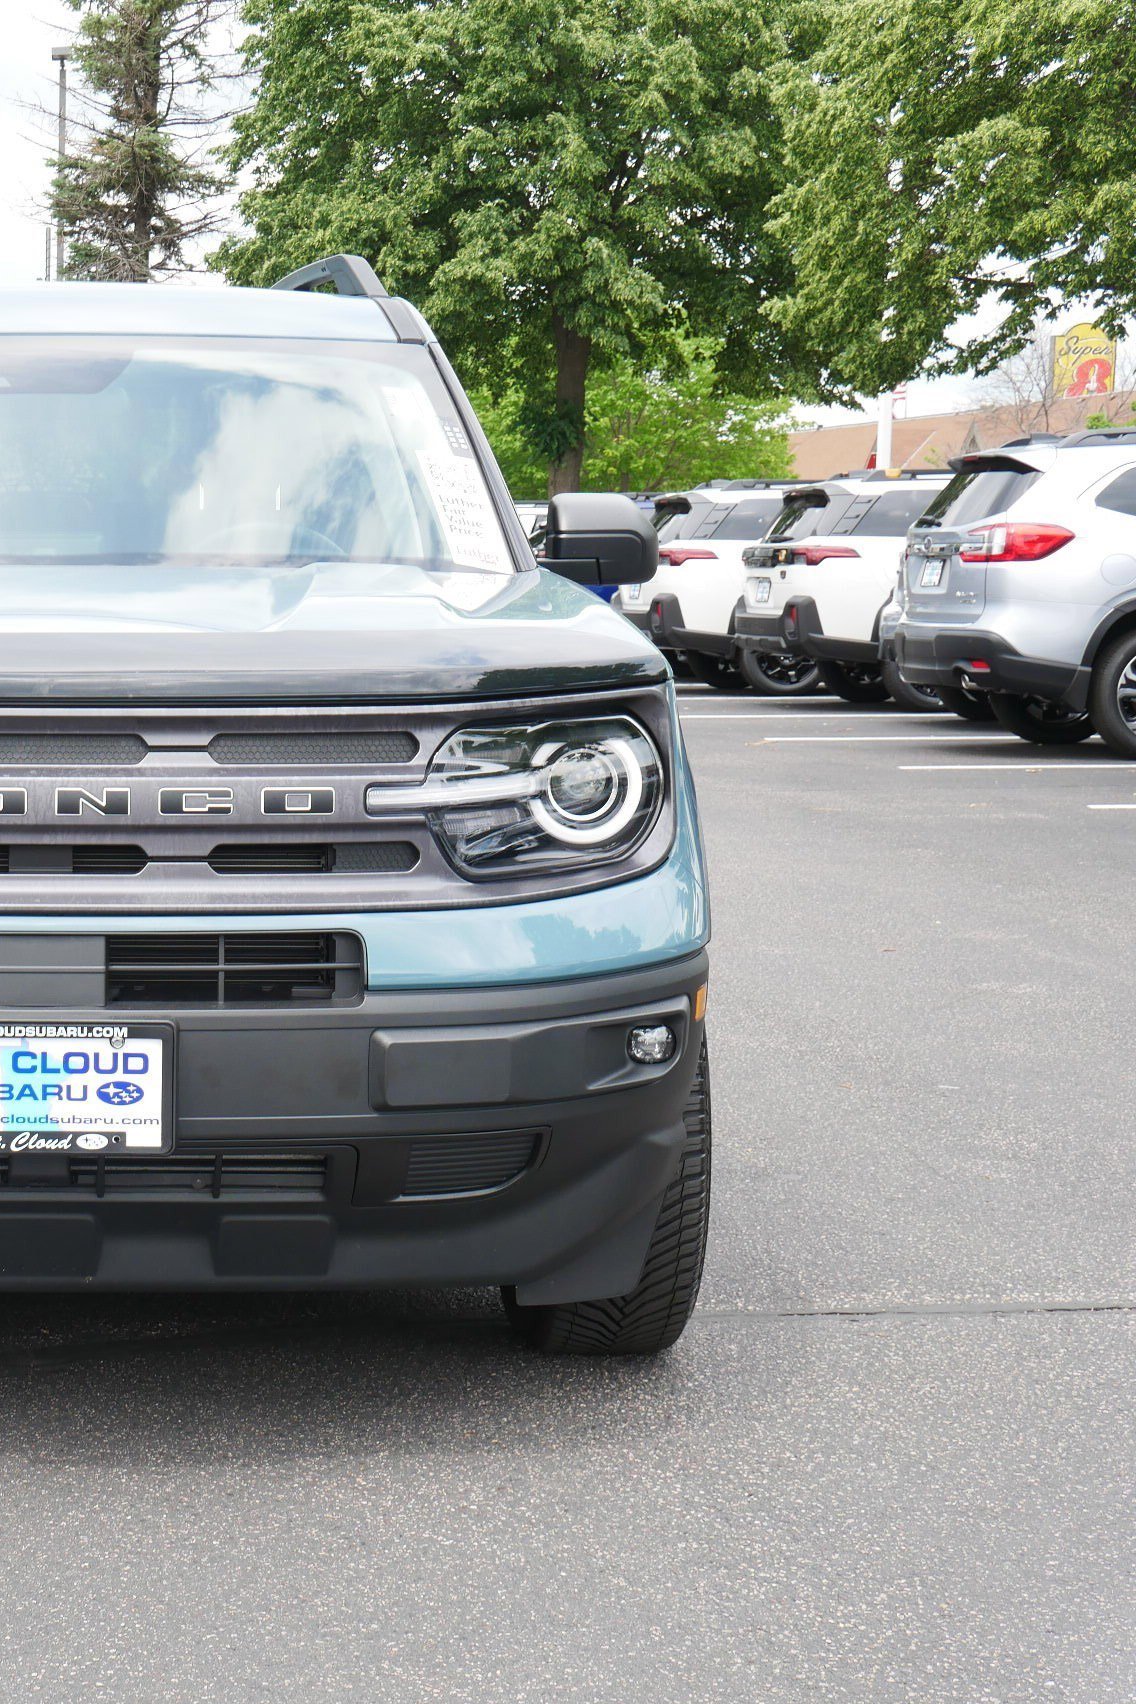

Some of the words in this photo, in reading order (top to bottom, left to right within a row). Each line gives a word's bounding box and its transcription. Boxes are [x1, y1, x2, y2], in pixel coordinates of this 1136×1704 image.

[1059, 336, 1112, 365] Super
[11, 1051, 149, 1075] CLOUD
[10, 1131, 73, 1152] Cloud
